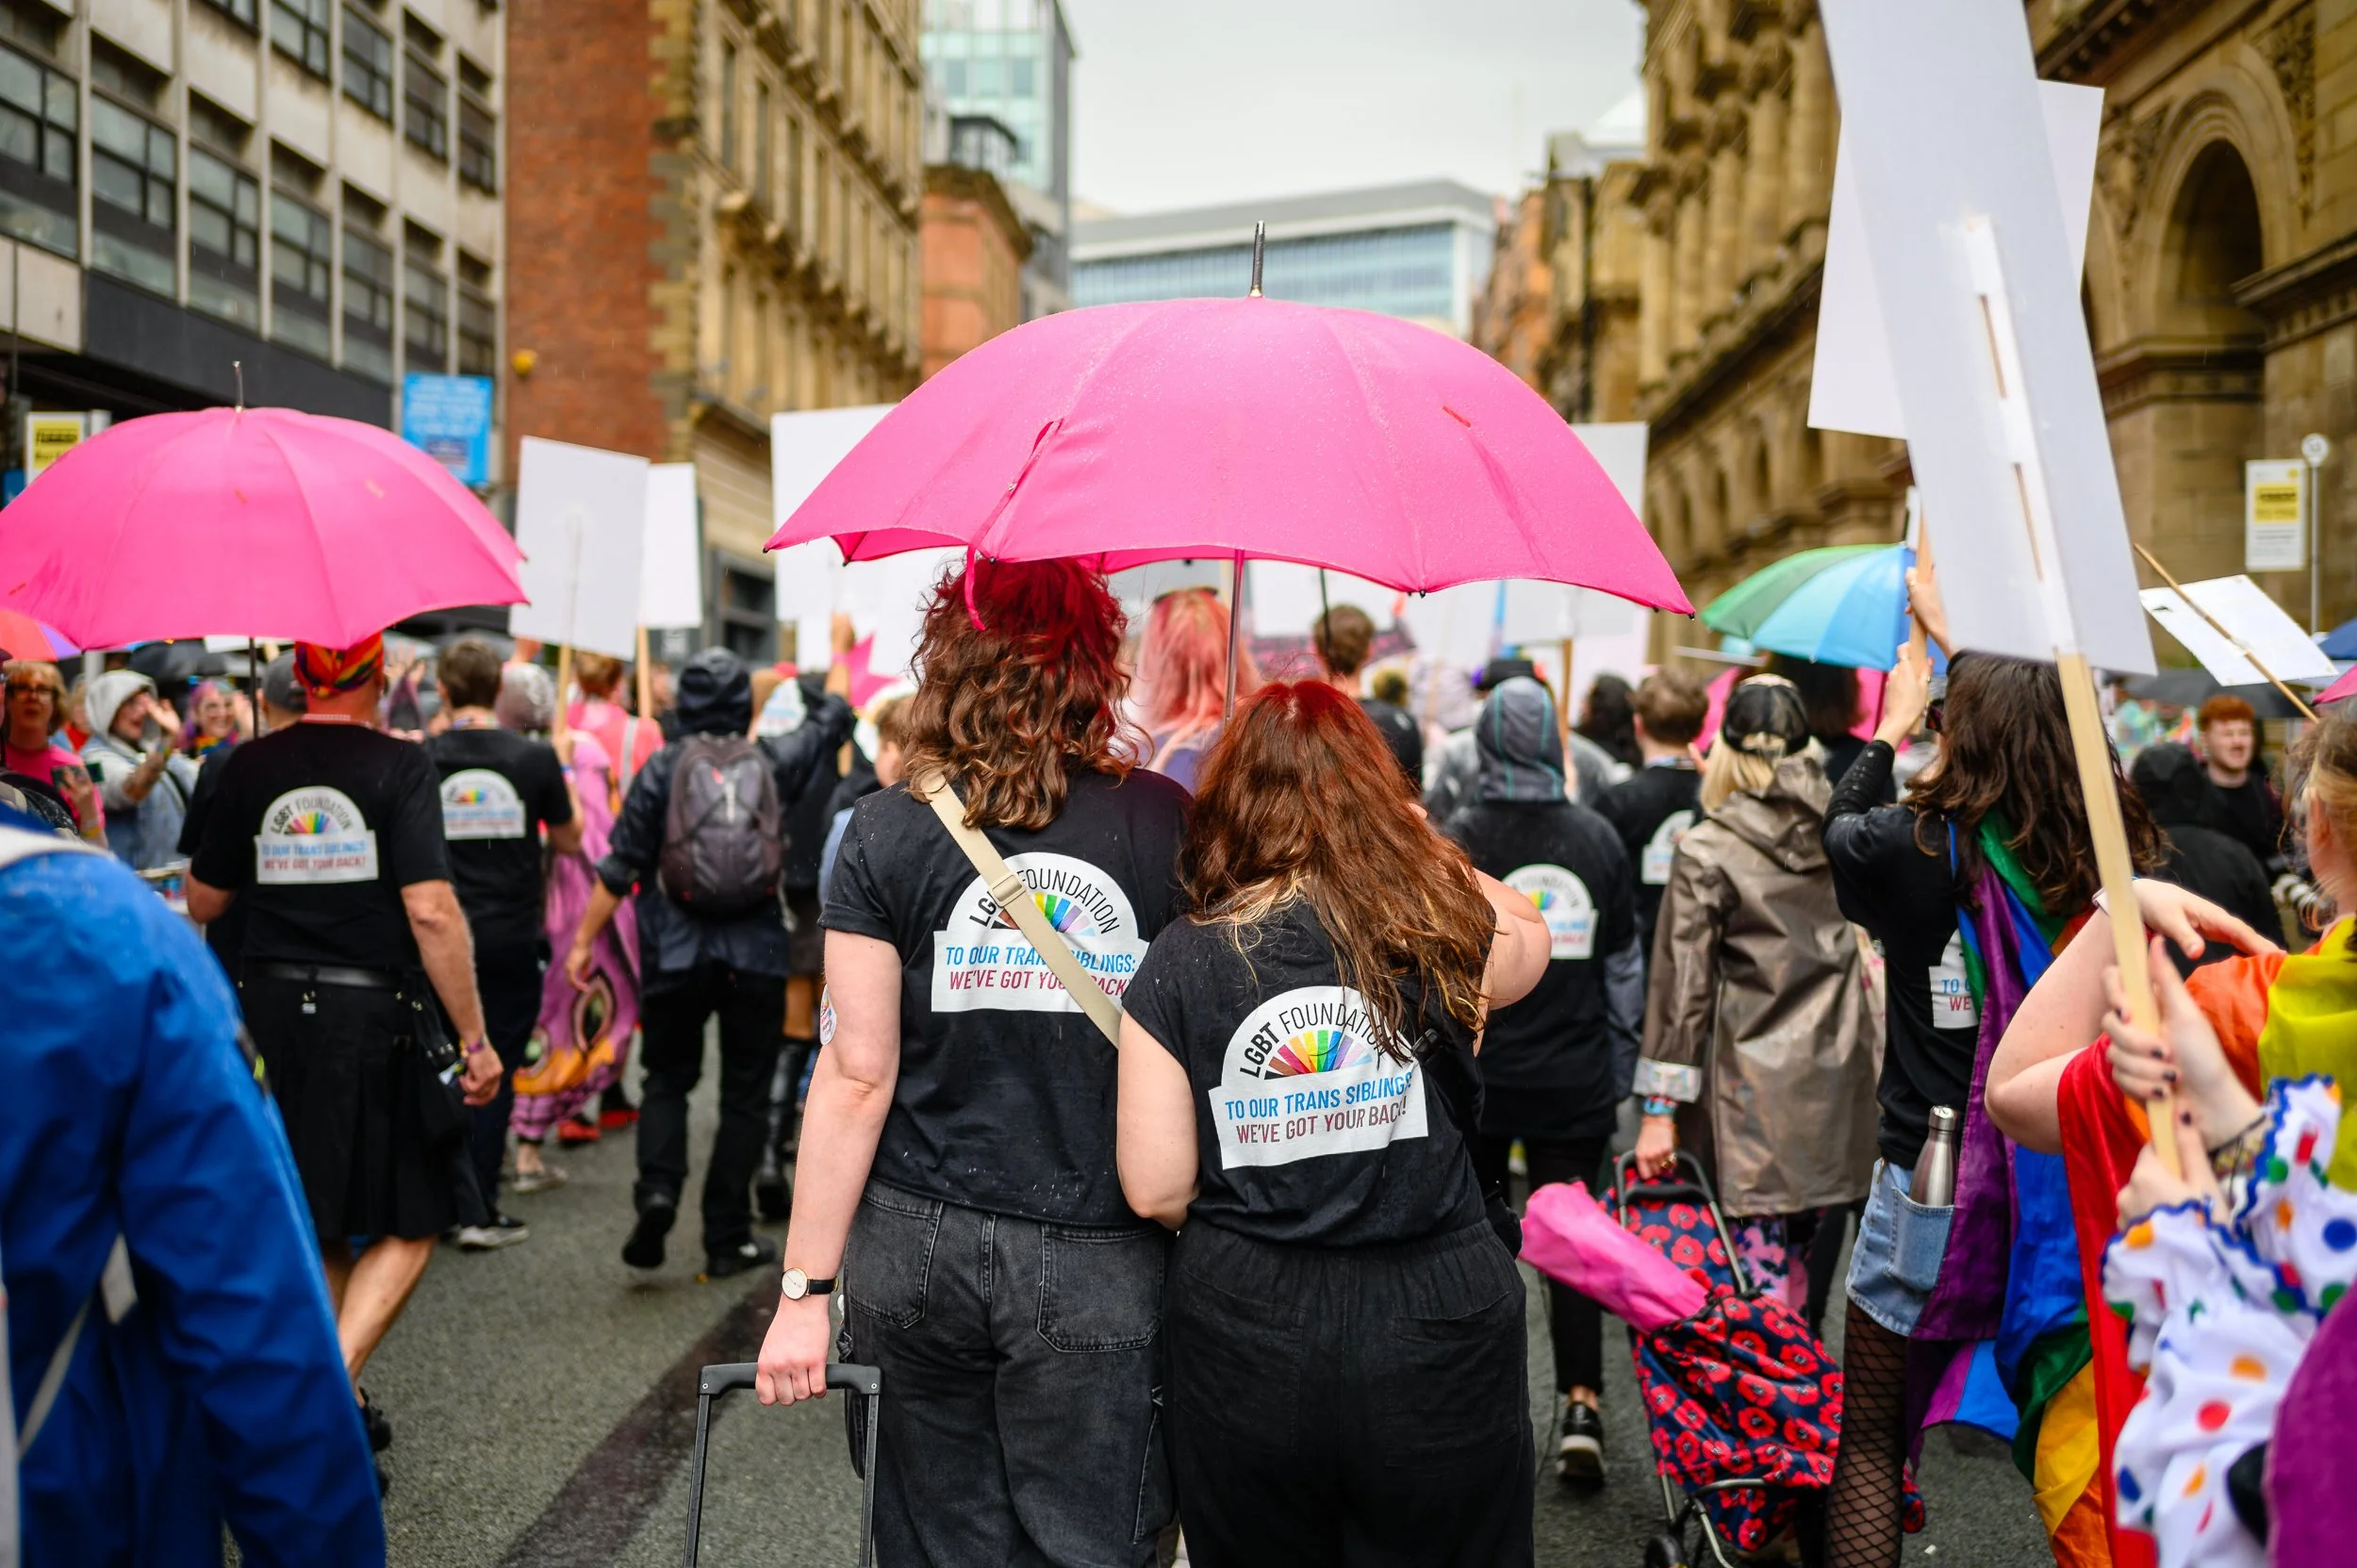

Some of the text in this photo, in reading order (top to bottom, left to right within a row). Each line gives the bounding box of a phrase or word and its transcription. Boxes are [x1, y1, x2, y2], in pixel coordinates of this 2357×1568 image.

[271, 796, 354, 834] LGBT FOUNDATION
[969, 897, 997, 927] LG
[946, 946, 1136, 973] TO OUR TRA IBLINGS:
[949, 969, 1131, 996] WE'VE GOT YO ACK
[1941, 978, 1959, 994] TO
[1239, 1021, 1279, 1079] LGBT
[1225, 1099, 1244, 1120] TO
[1249, 1098, 1278, 1118] OUR
[1284, 1088, 1341, 1114] TRANS
[1236, 1123, 1280, 1144] WE'VE
[1286, 1115, 1318, 1140] GOT
[1324, 1109, 1366, 1132] YOUR
